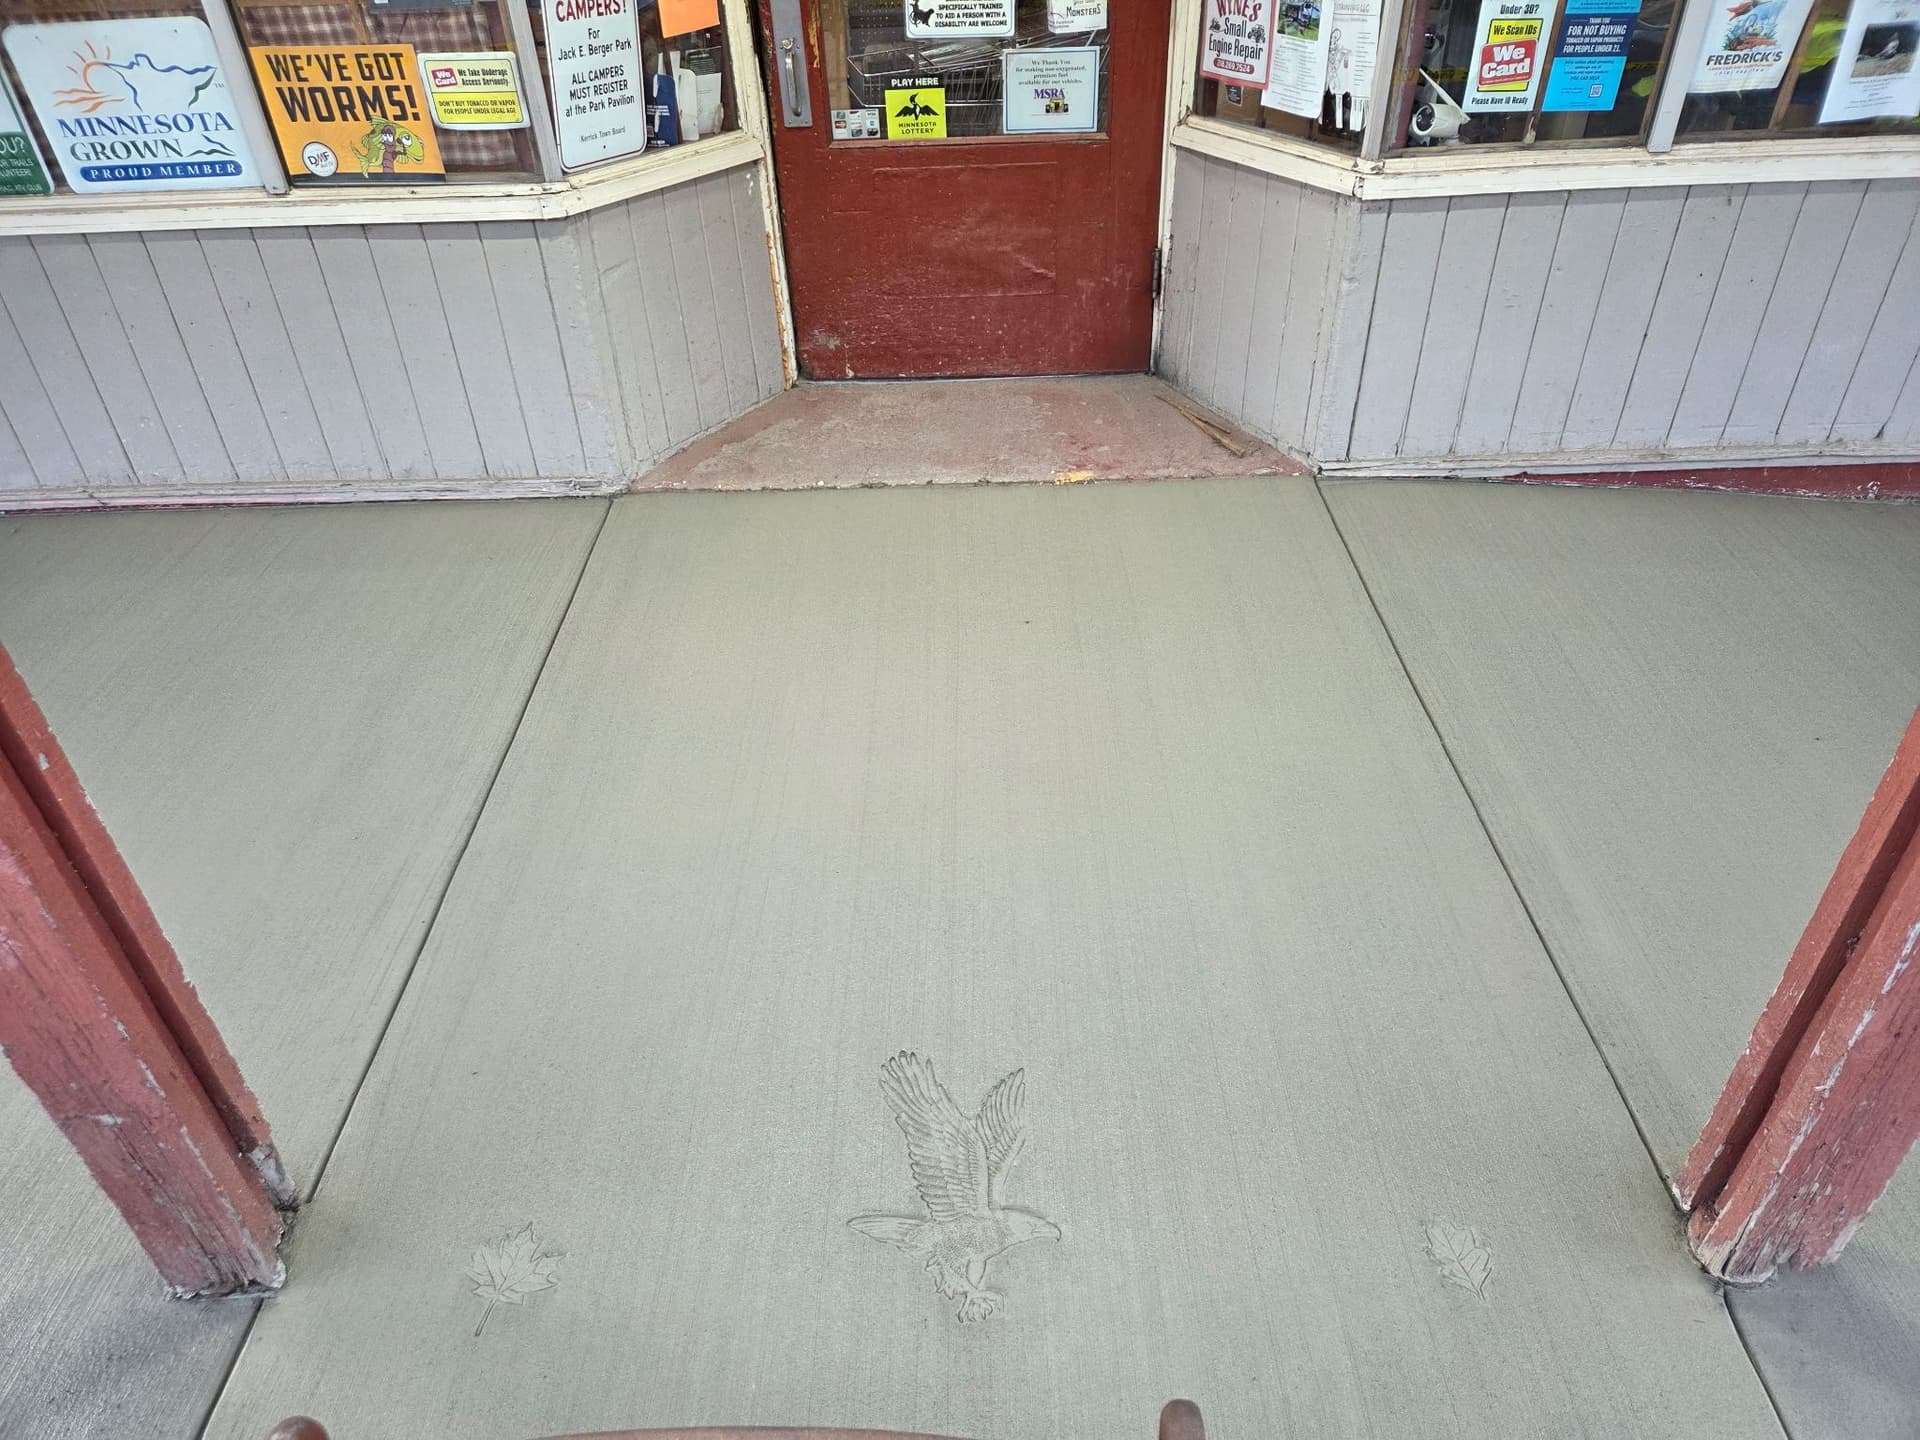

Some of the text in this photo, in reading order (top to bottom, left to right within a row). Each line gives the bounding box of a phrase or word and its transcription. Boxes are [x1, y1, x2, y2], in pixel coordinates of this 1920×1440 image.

[556, 0, 626, 22] CAMPERS!
[1500, 4, 1522, 15] Under
[935, 20, 967, 28] DISABILITY
[1224, 17, 1247, 39] Small
[1493, 24, 1538, 35] We Scan IDs
[1567, 25, 1627, 36] FOR NOT BUYING
[588, 28, 600, 40] For
[558, 37, 632, 61] Jack E. Berger Park
[1208, 33, 1264, 62] Engine Repair
[1493, 44, 1526, 62] We
[1563, 45, 1575, 53] FOR
[1575, 45, 1595, 53] PEOPLE
[1594, 45, 1614, 53] UNDER
[1706, 51, 1783, 66] FREDRICK'S
[265, 52, 406, 82] WE'VE GOT
[467, 68, 480, 76] Take
[481, 68, 508, 77] Underage
[1481, 58, 1531, 79] Card
[572, 65, 624, 85] ALL CAMPERS
[461, 78, 481, 86] Access
[891, 77, 939, 88] PLAY HERE
[569, 79, 629, 101] MUST REGISTER
[1034, 88, 1066, 99] MSRA
[276, 85, 421, 122] WORMS!
[565, 94, 635, 118] at the Park Pavilion
[1471, 97, 1489, 105] Please
[1490, 96, 1504, 105] Have
[1512, 96, 1528, 105] Ready
[56, 112, 236, 138] MINNESOTA
[599, 129, 611, 138] Town
[612, 125, 626, 136] Board
[898, 121, 937, 129] MINNESOTA
[901, 127, 935, 135] LOTTERY
[70, 139, 184, 161] GROWN
[90, 167, 152, 179] PROUD
[160, 163, 237, 176] MEMBER
